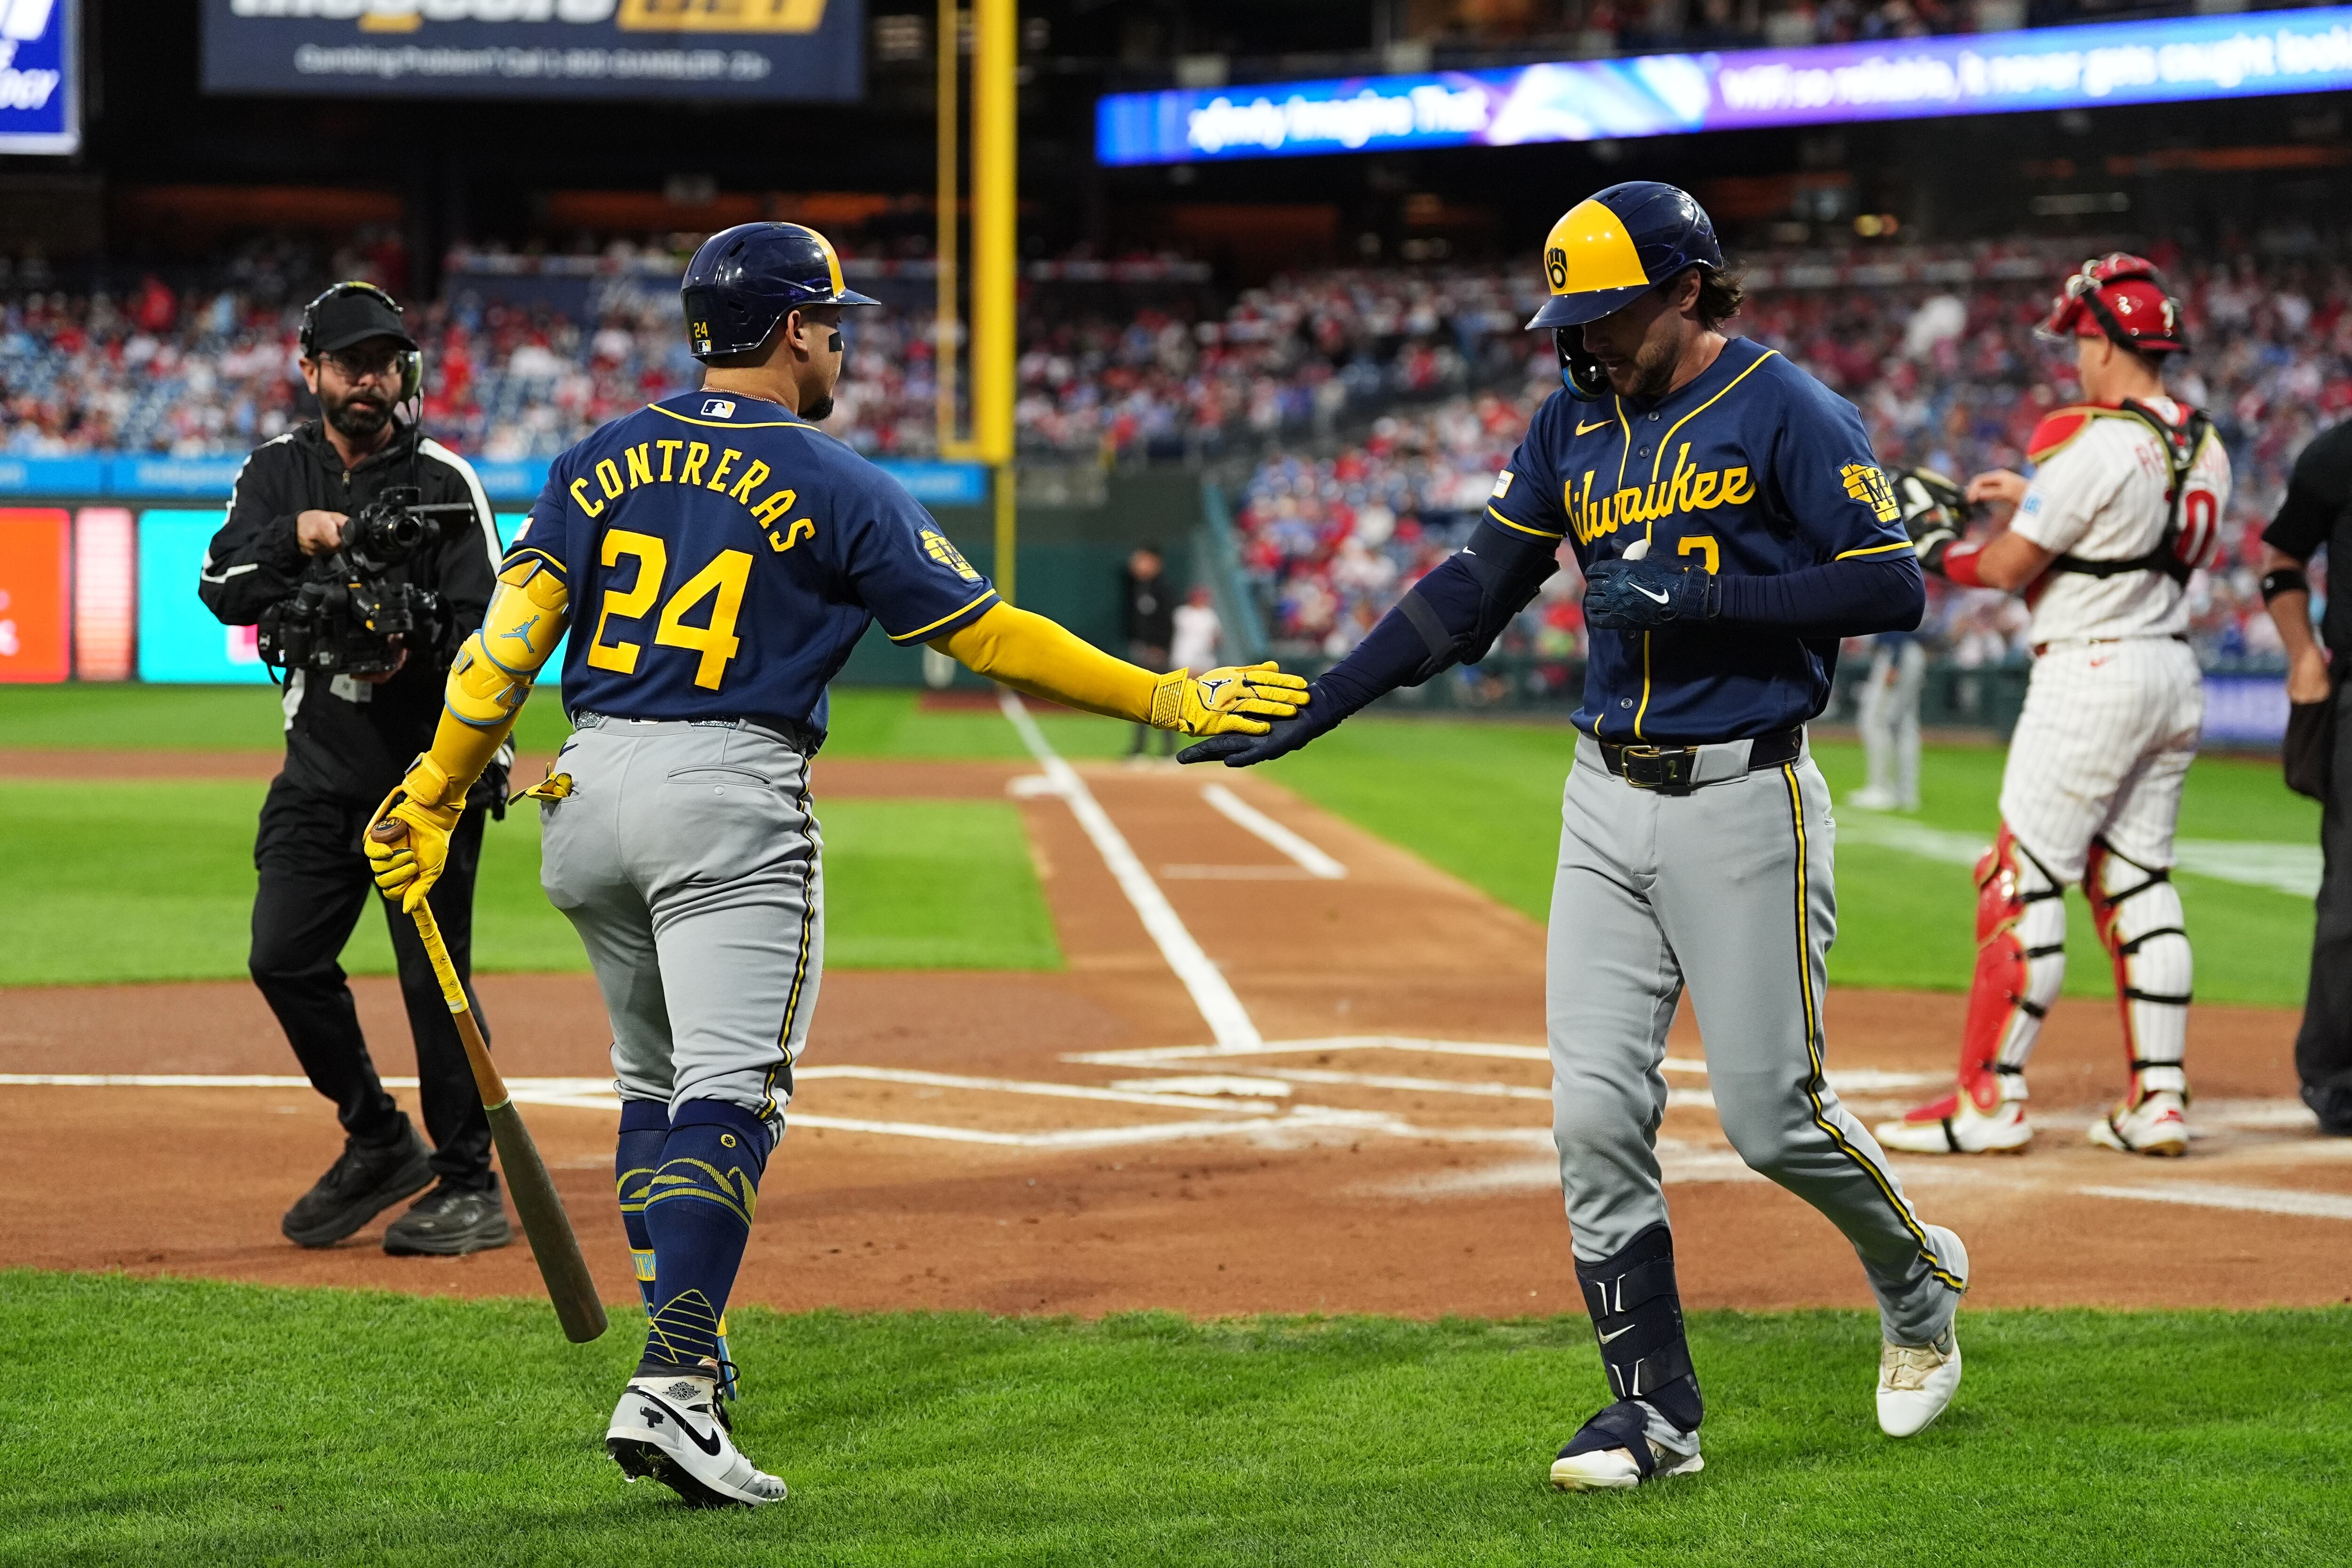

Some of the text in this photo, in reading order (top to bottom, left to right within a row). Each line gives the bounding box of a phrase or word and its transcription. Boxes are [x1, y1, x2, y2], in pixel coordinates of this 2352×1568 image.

[694, 322, 708, 338] 24
[569, 439, 816, 553] CONTRERAS
[587, 528, 754, 691] 24
[1668, 760, 1677, 779] 2
[378, 819, 395, 829] 24
